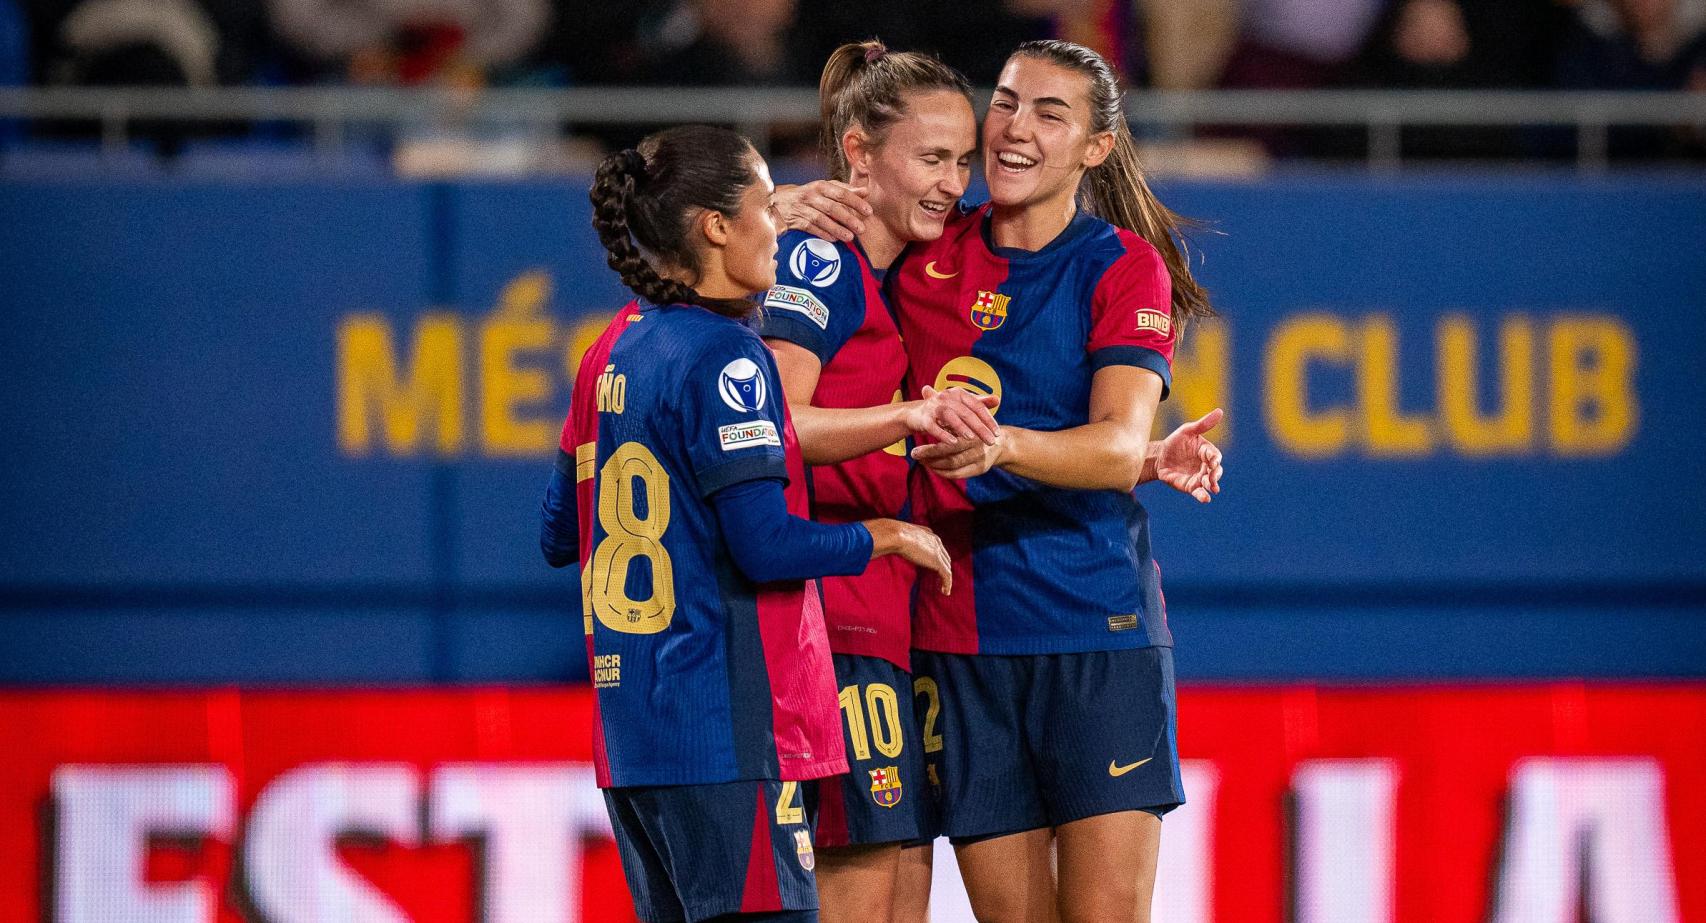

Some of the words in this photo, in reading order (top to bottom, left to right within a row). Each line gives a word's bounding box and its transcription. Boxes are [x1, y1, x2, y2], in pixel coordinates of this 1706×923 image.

[1268, 315, 1637, 455] CLUB
[839, 683, 904, 760] 10
[914, 676, 943, 753] 2
